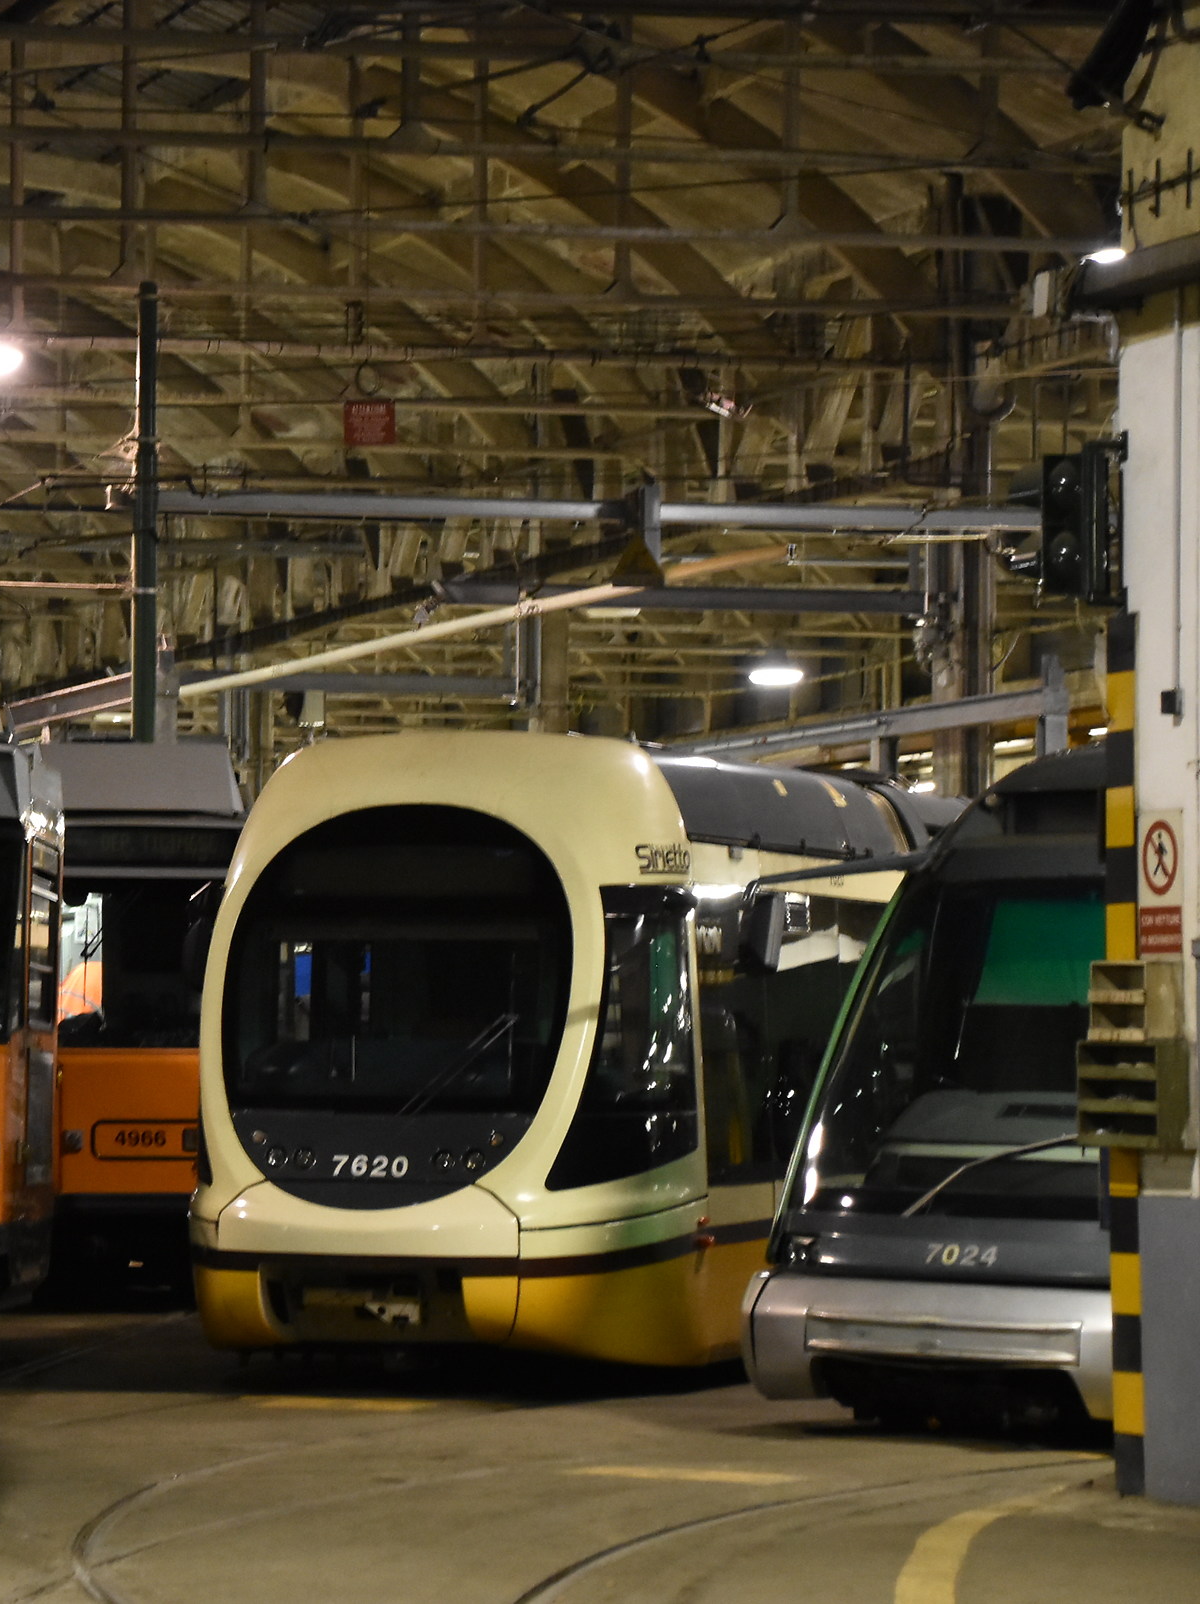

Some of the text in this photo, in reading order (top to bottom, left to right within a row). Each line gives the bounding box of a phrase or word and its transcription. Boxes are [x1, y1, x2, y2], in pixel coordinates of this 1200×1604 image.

[114, 1129, 167, 1147] 4966
[331, 1153, 410, 1179] 7620
[924, 1242, 999, 1268] 7024
